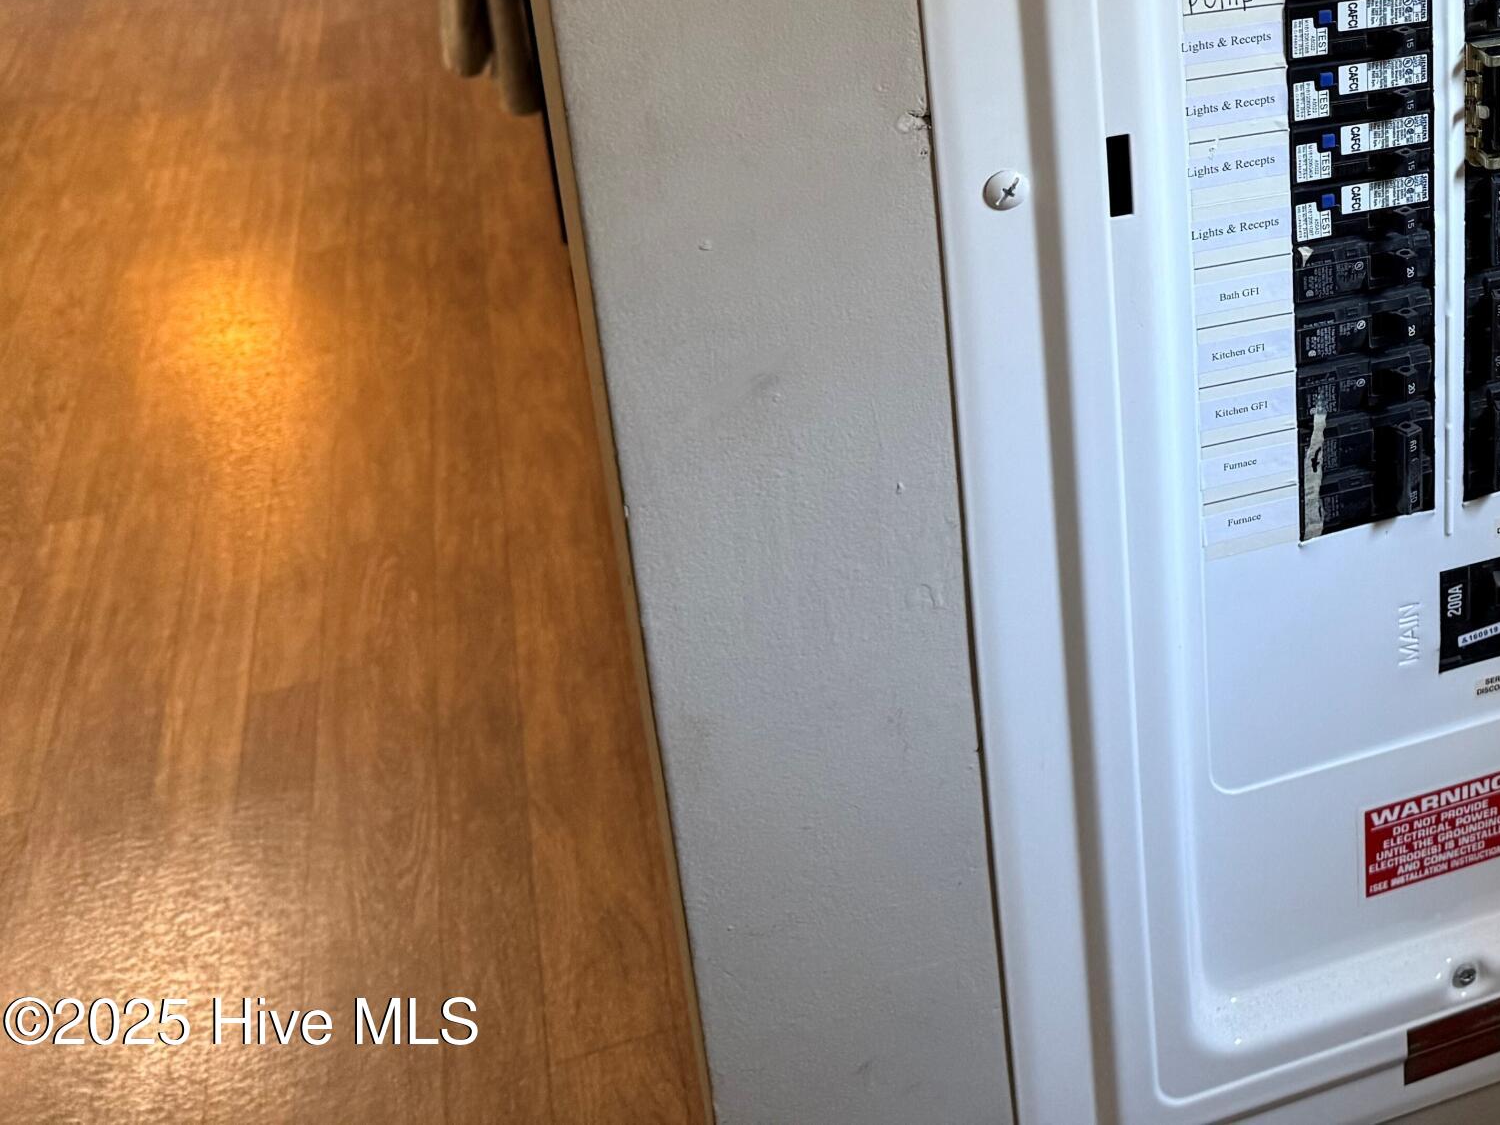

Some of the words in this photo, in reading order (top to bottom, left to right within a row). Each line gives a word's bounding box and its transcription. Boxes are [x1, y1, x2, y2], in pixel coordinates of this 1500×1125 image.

[1348, 2, 1359, 29] CAFCI
[1181, 39, 1214, 53] Lights
[1217, 37, 1228, 48] &
[1231, 32, 1272, 46] Recepts
[1318, 29, 1328, 54] TEST
[1406, 38, 1415, 49] 15
[1348, 65, 1359, 92] CAFCI
[1185, 103, 1218, 117] Lights
[1220, 100, 1231, 111] &
[1234, 95, 1276, 111] Recepts
[1320, 91, 1329, 115] TEST
[1406, 100, 1415, 110] 15
[1350, 126, 1361, 152] CAFCI
[1187, 165, 1220, 179] Lights
[1221, 162, 1232, 172] &
[1235, 155, 1276, 170] Recepts
[1321, 152, 1331, 177] TEST
[1407, 160, 1416, 171] 15
[1351, 186, 1361, 211] CAFCI
[1191, 227, 1224, 241] Lights
[1226, 224, 1237, 234] &
[1240, 217, 1280, 232] Recepts
[1321, 212, 1331, 236] TEST
[1407, 218, 1416, 230] 15
[1406, 266, 1415, 278] 20
[1219, 291, 1240, 302] Bath
[1242, 287, 1260, 297] GFI
[1408, 325, 1416, 337] 20
[1211, 348, 1246, 362] Kitchen
[1248, 343, 1265, 354] GFI
[1408, 383, 1416, 395] 20
[1215, 405, 1249, 419] Kitchen
[1251, 401, 1268, 412] GFI
[1223, 458, 1257, 472] Furnace
[1227, 513, 1262, 527] Furnace
[1447, 583, 1463, 617] 200A
[1398, 601, 1421, 666] MAIN
[1383, 821, 1451, 849] ELECTRICAL
[1455, 806, 1498, 825] POWER
[1392, 823, 1409, 837] DO
[1413, 815, 1438, 830] NOT
[1440, 799, 1489, 820] PROVIDE
[1369, 845, 1442, 874] ELECTRODE(S)
[1444, 838, 1455, 850] IS
[1376, 845, 1408, 861] UNTIL
[1413, 837, 1433, 850] THE
[1397, 860, 1421, 875] AND
[1424, 840, 1485, 866] CONNECTED
[1369, 880, 1388, 894] (SEE
[1390, 862, 1449, 887] INSTALLATION
